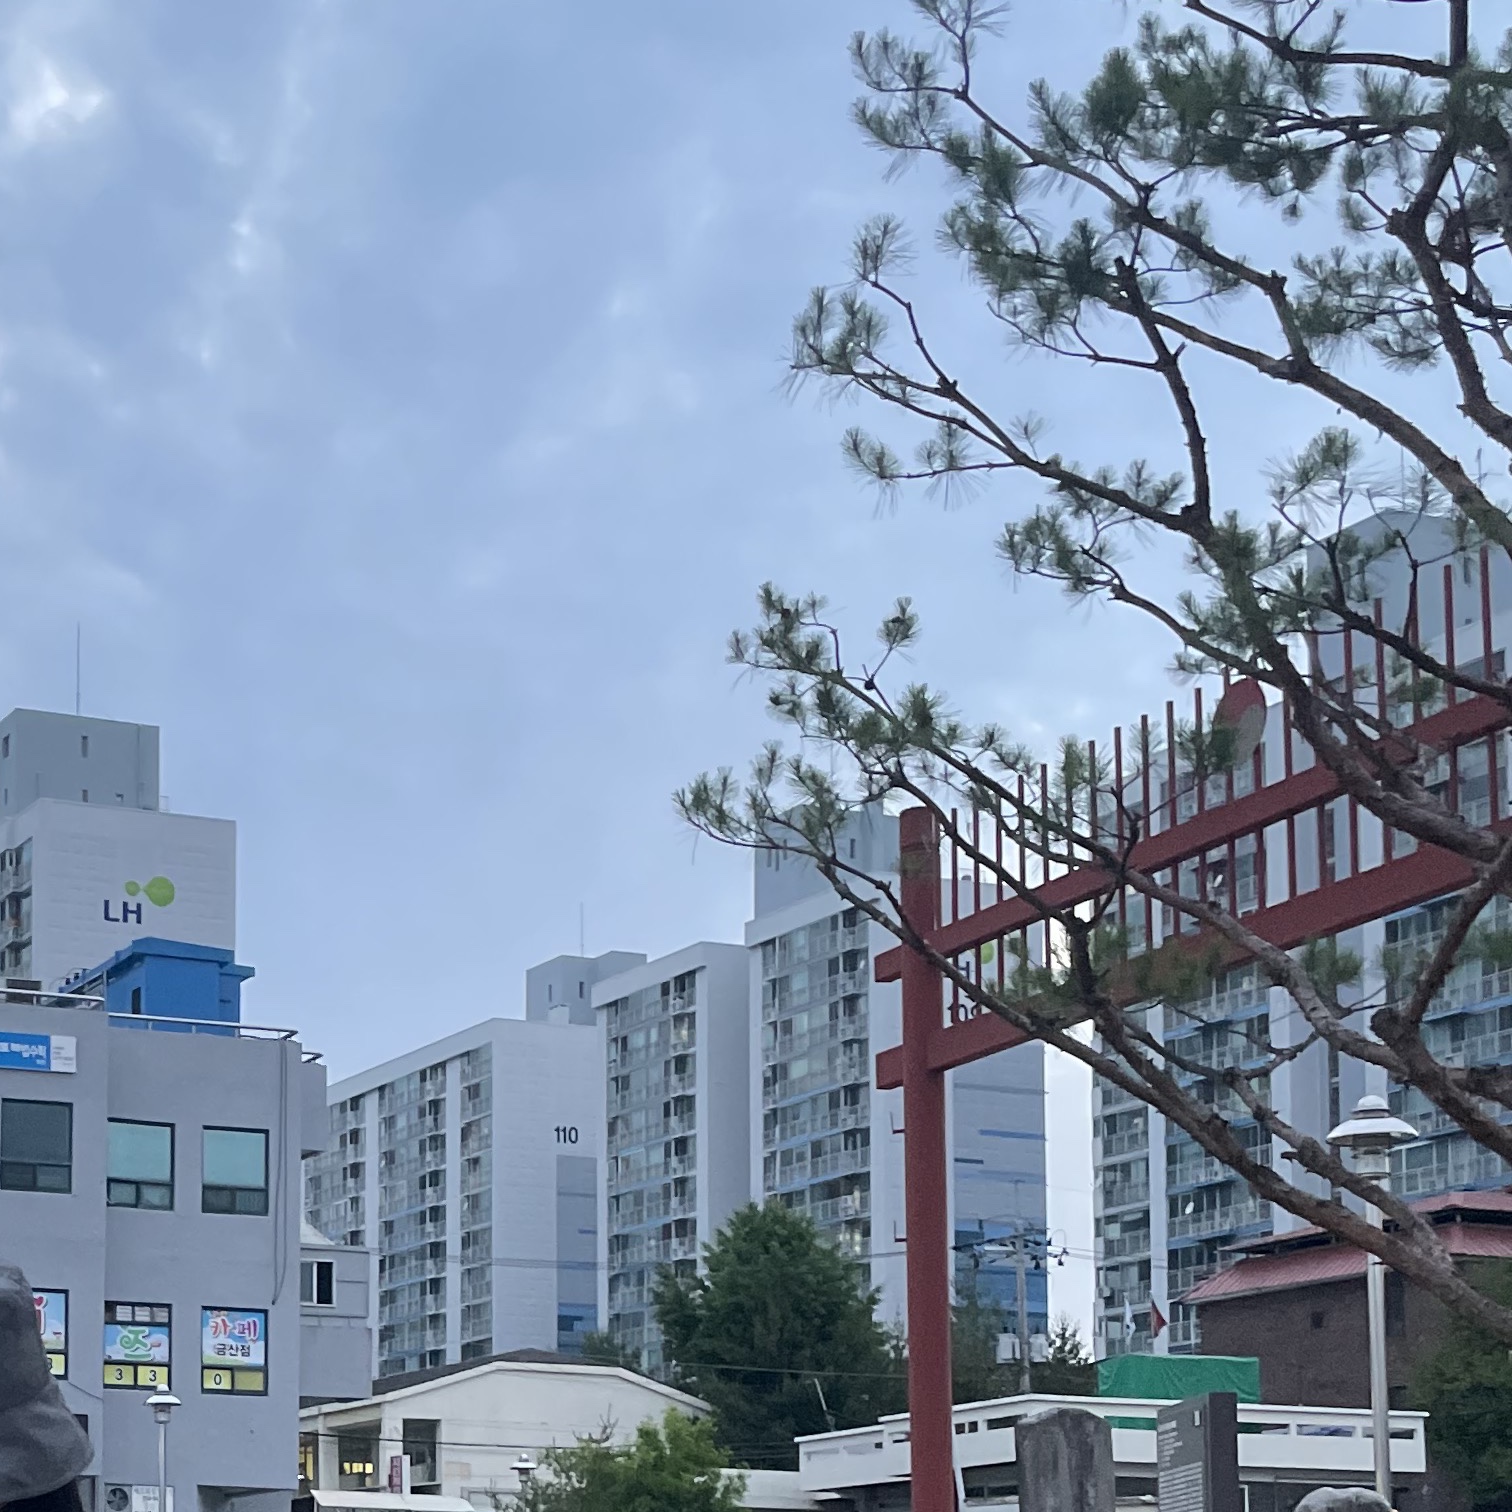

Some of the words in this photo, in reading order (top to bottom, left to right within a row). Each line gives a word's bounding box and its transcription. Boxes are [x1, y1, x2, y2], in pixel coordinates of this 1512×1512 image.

[103, 899, 142, 925] LH
[554, 1125, 579, 1145] 110
[209, 1319, 258, 1338] 카페
[215, 1343, 251, 1357] 금산점
[115, 1368, 124, 1381] 3
[148, 1370, 157, 1382] 3
